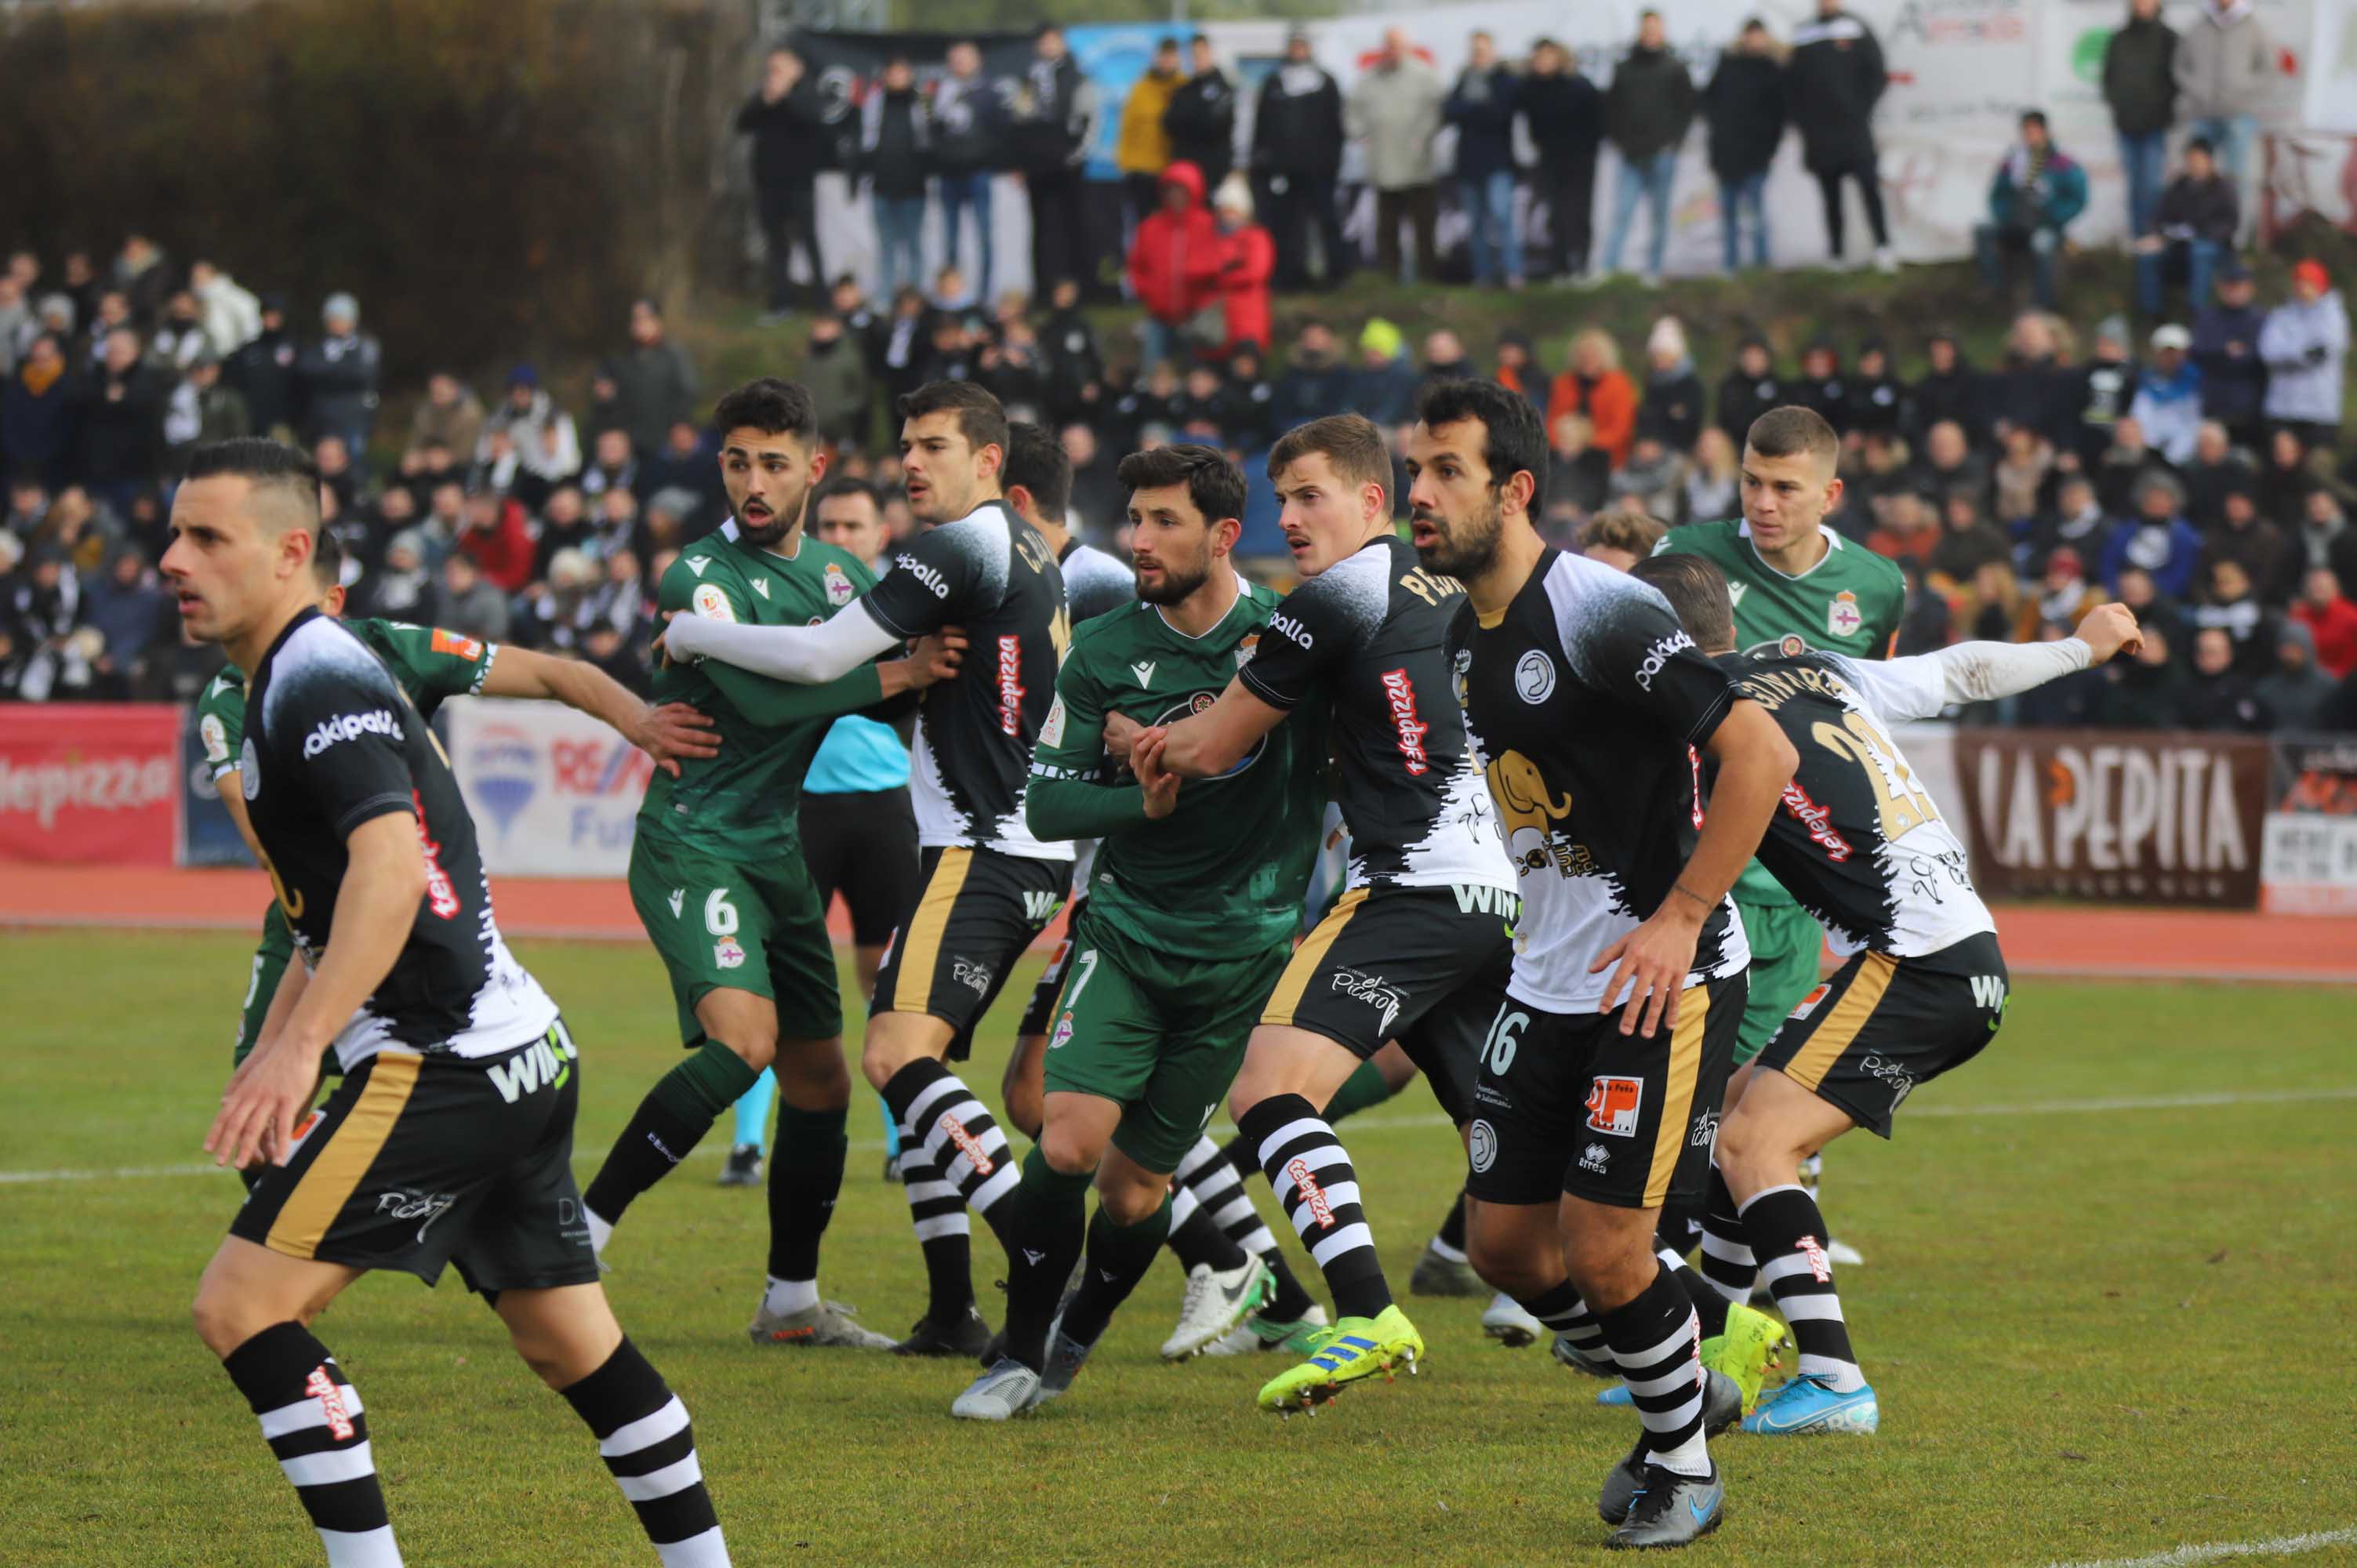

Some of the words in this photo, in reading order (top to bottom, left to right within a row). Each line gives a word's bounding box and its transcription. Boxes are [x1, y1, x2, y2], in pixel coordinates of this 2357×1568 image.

[1267, 607, 1313, 649] pallo
[996, 635, 1026, 738] telepizza
[1382, 669, 1429, 778] telepizza
[2049, 746, 2247, 870] PEPITA
[705, 887, 739, 935] 6
[1066, 949, 1098, 1008] 7
[1362, 976, 1382, 989] el
[1480, 1001, 1531, 1076] 16
[1287, 1159, 1336, 1229] telepizza
[1795, 1235, 1831, 1283] pizza
[306, 1364, 354, 1441] epizza
